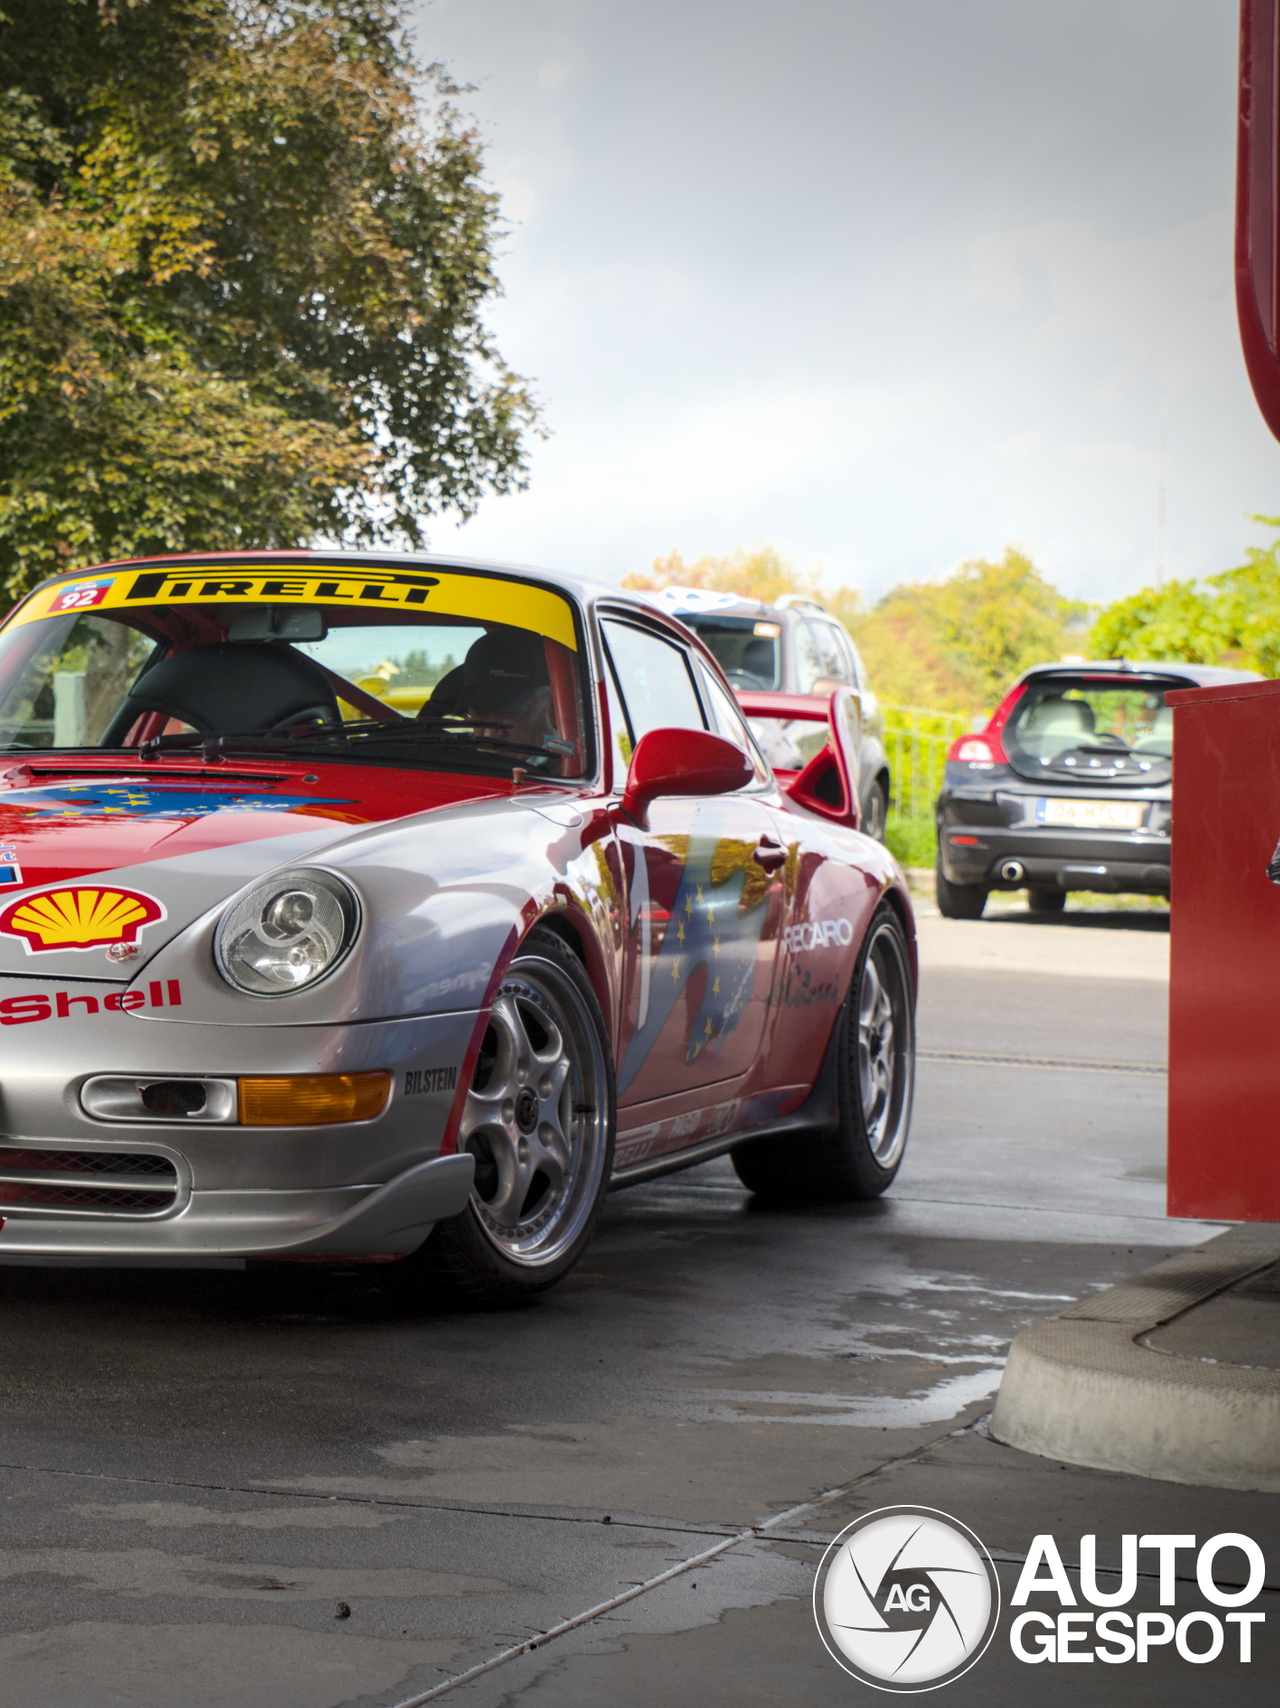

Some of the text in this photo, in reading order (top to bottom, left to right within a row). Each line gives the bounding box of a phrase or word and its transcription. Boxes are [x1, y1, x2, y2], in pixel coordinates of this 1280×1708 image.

[60, 589, 98, 609] 92
[125, 569, 441, 604] PIRELLI
[783, 917, 853, 953] RECARO
[404, 1066, 457, 1096] BILSTEIN
